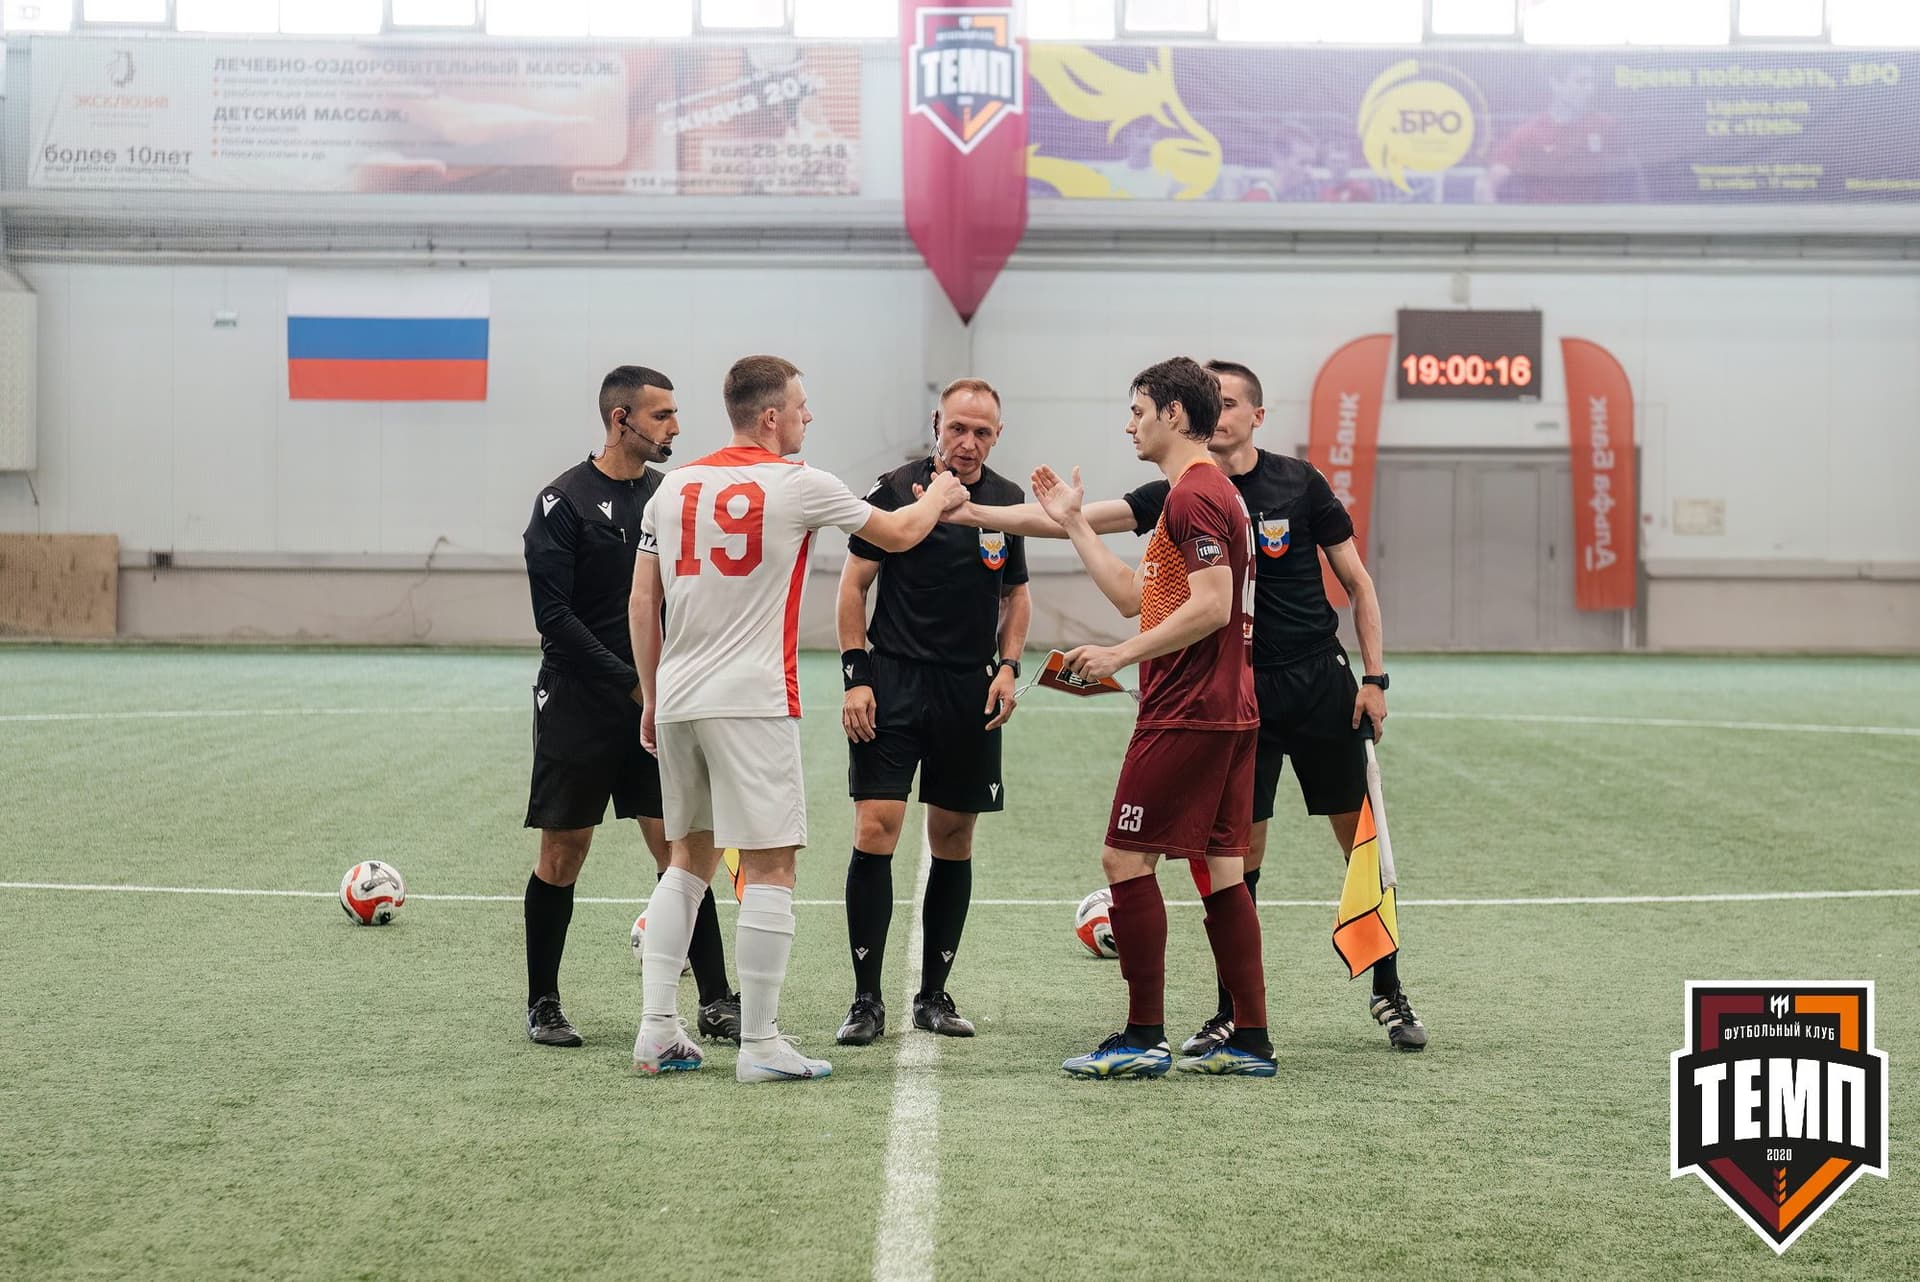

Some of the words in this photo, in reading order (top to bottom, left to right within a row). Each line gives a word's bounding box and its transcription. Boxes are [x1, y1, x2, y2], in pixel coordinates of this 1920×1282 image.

[920, 48, 1013, 98] ТЕМП
[213, 104, 306, 122] ДЕТСКИЙ
[1391, 110, 1462, 134] .БРО
[44, 143, 117, 164] более
[1402, 355, 1532, 386] 19:00:16
[1328, 391, 1360, 466] Банк
[675, 481, 766, 577] 19
[1117, 804, 1144, 833] 23
